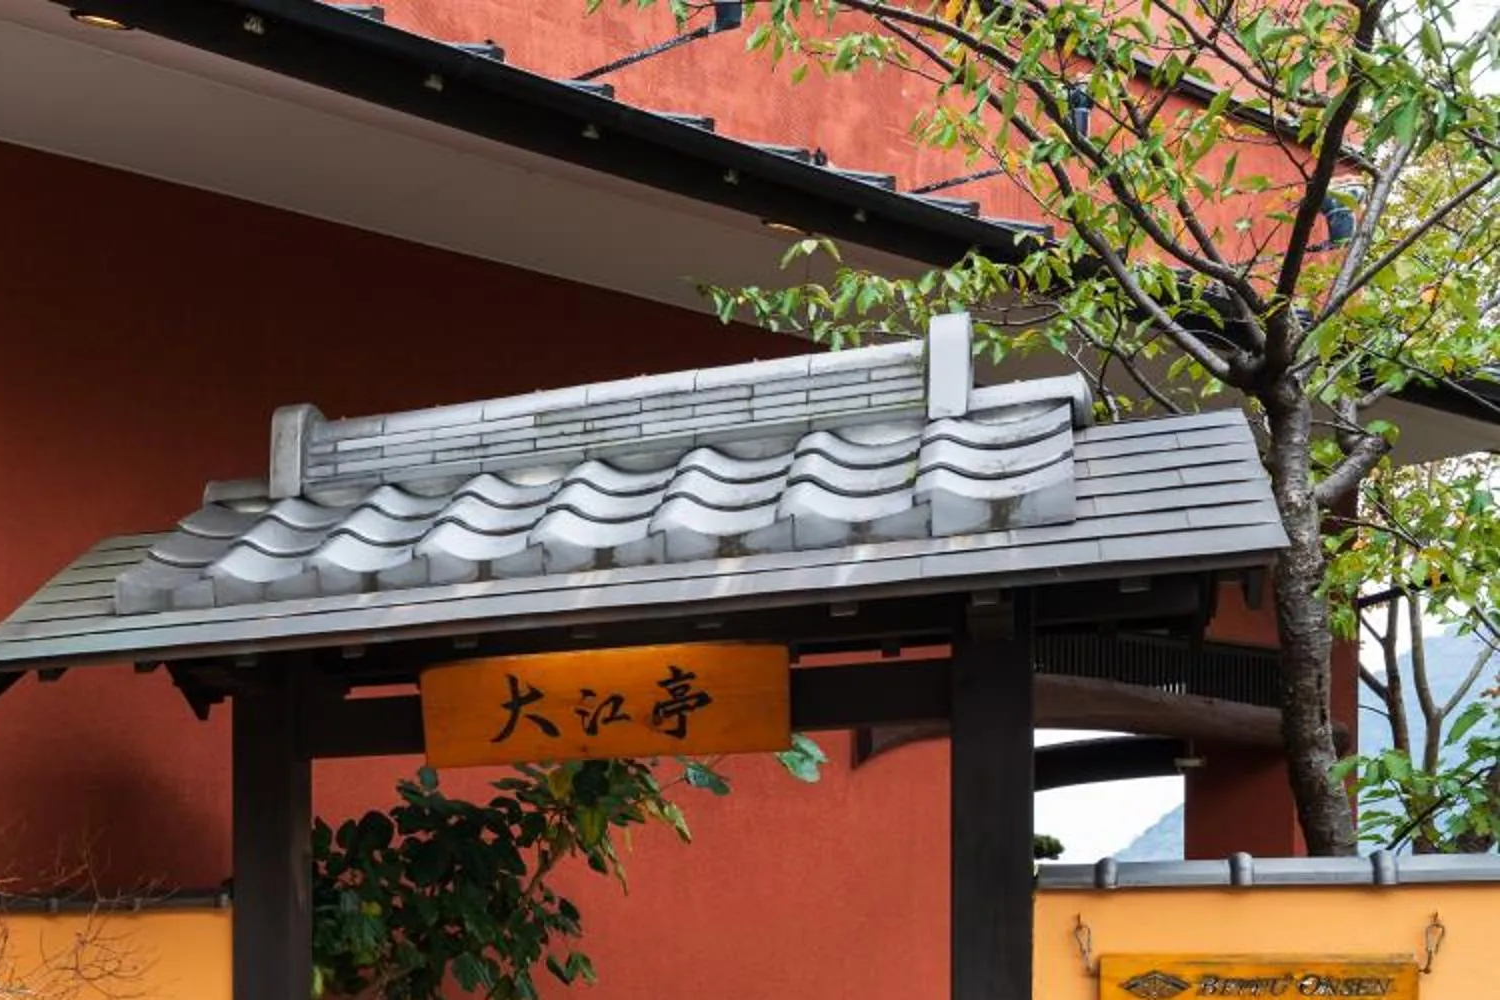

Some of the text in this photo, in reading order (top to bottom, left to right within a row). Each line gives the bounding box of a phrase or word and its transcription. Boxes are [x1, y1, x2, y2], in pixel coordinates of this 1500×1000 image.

[490, 664, 712, 743] 大江亭
[1297, 973, 1393, 997] ONSEN
